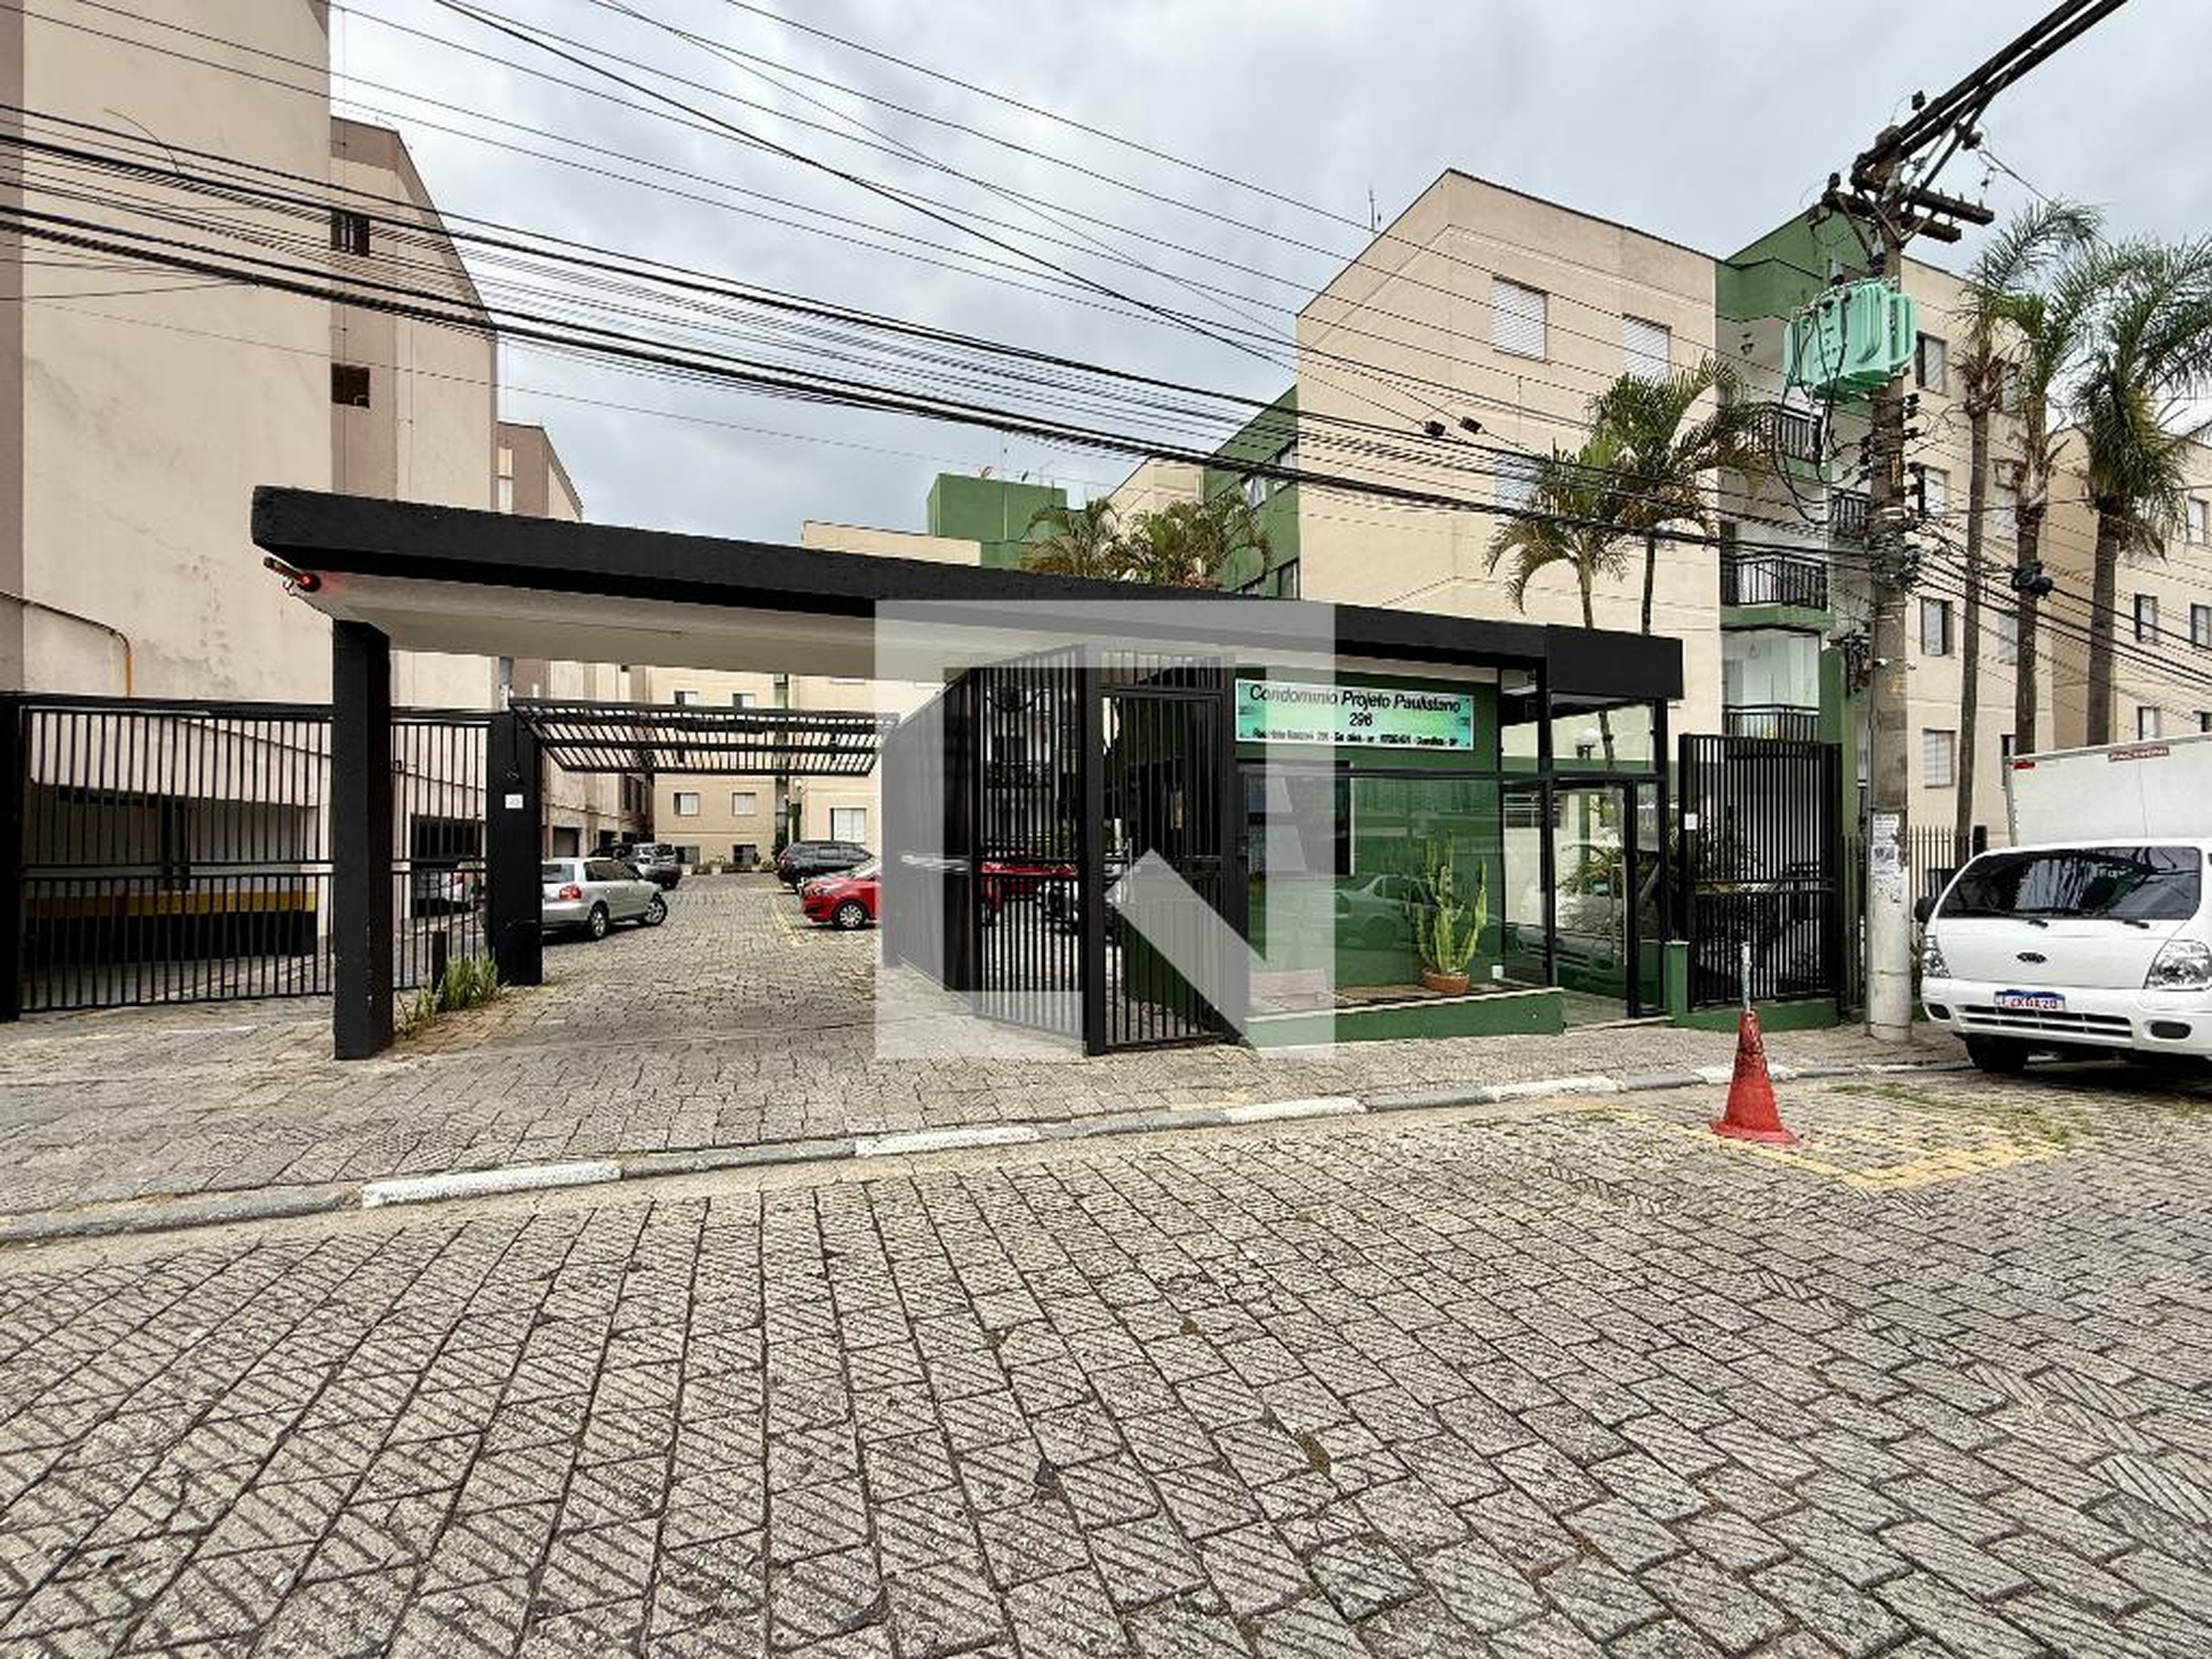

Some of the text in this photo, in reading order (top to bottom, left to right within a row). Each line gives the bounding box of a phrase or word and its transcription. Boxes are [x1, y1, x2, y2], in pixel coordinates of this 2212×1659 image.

[1341, 691, 1390, 710] Projeto
[1393, 694, 1461, 713] Paulistano
[1349, 712, 1373, 726] 296
